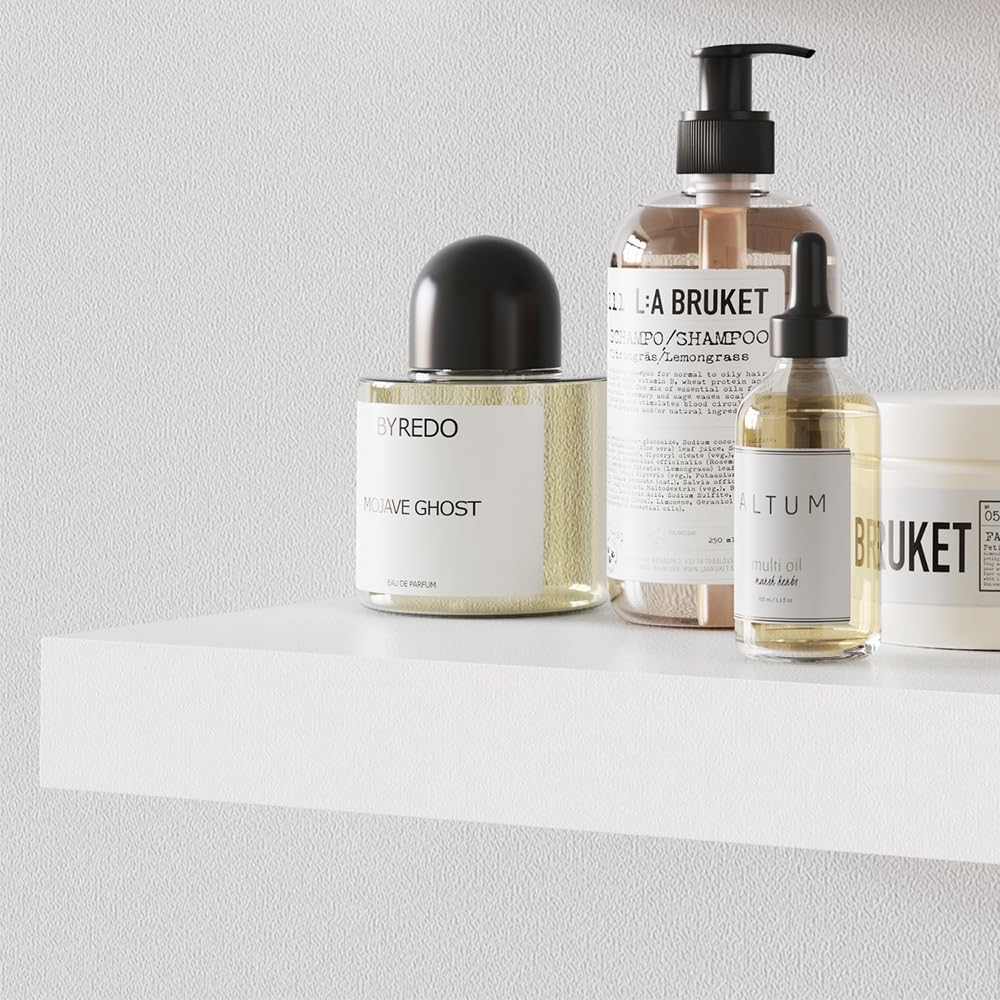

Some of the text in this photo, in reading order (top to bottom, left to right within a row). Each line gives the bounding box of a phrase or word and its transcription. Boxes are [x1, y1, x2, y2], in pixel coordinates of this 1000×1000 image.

[636, 288, 665, 315] L:A
[672, 288, 769, 316] BRUKET
[707, 408, 738, 416] ingred
[377, 417, 459, 438] BYREDO
[364, 496, 482, 517] MOJAVE GHOST
[739, 492, 827, 516] ALTUM
[708, 536, 723, 544] 250
[855, 516, 972, 574] BRUKET
[752, 556, 781, 572] multi
[785, 555, 803, 572] oil
[410, 580, 437, 589] PARFUM
